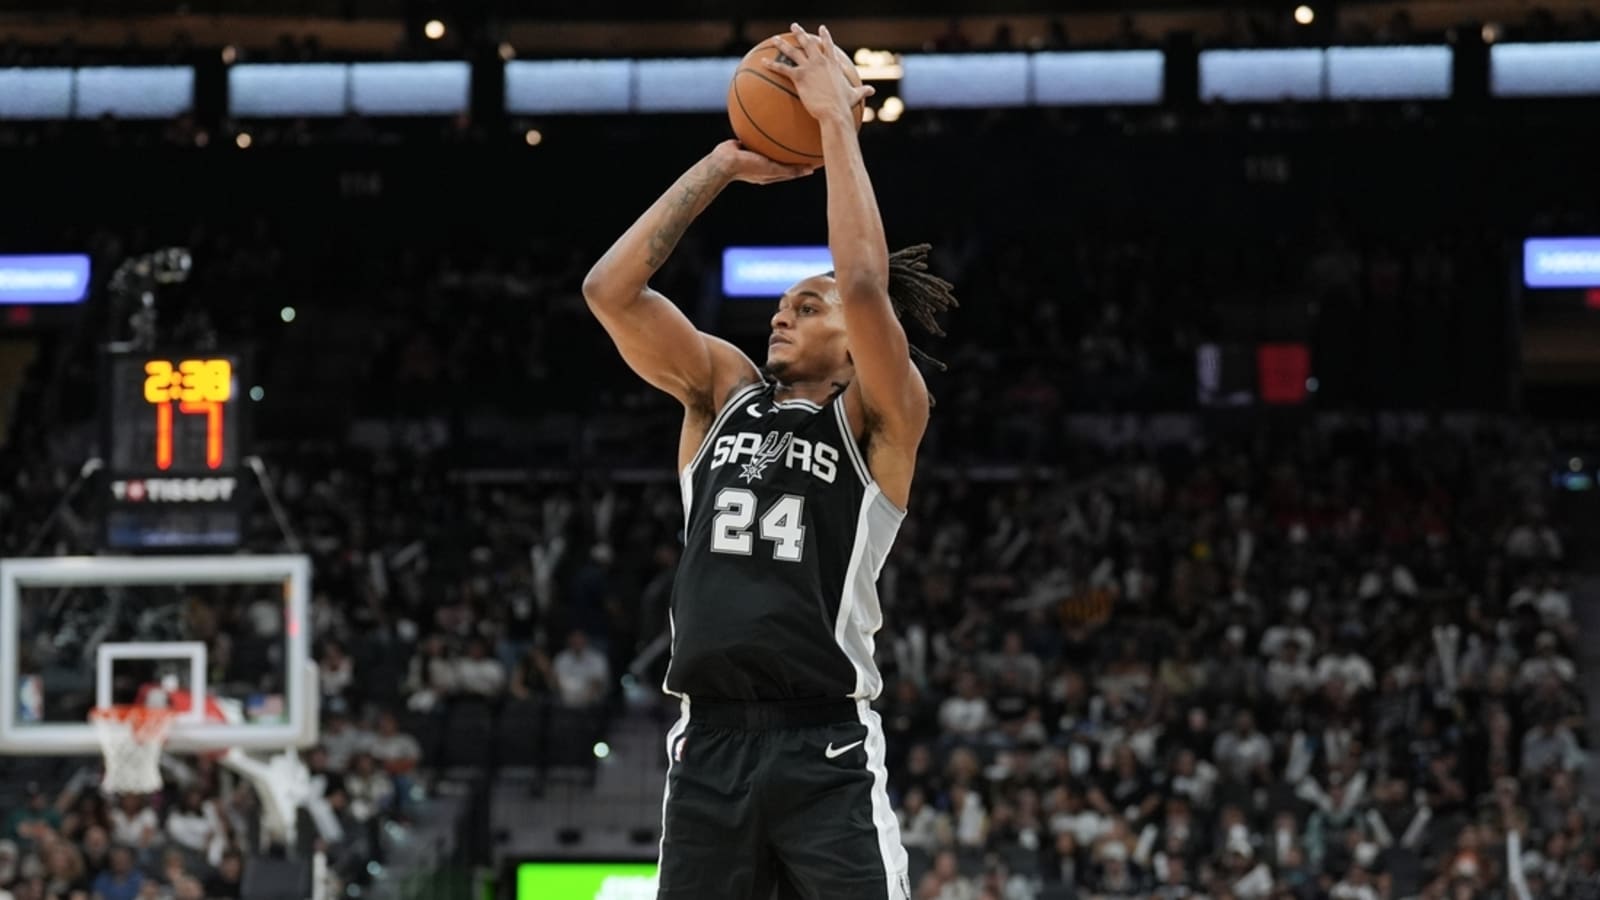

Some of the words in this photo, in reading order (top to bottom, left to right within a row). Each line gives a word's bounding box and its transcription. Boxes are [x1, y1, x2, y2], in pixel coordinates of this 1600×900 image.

[156, 399, 224, 471] 17
[710, 430, 840, 485] SPURS
[146, 476, 237, 502] TISSOT
[710, 487, 806, 563] 24
